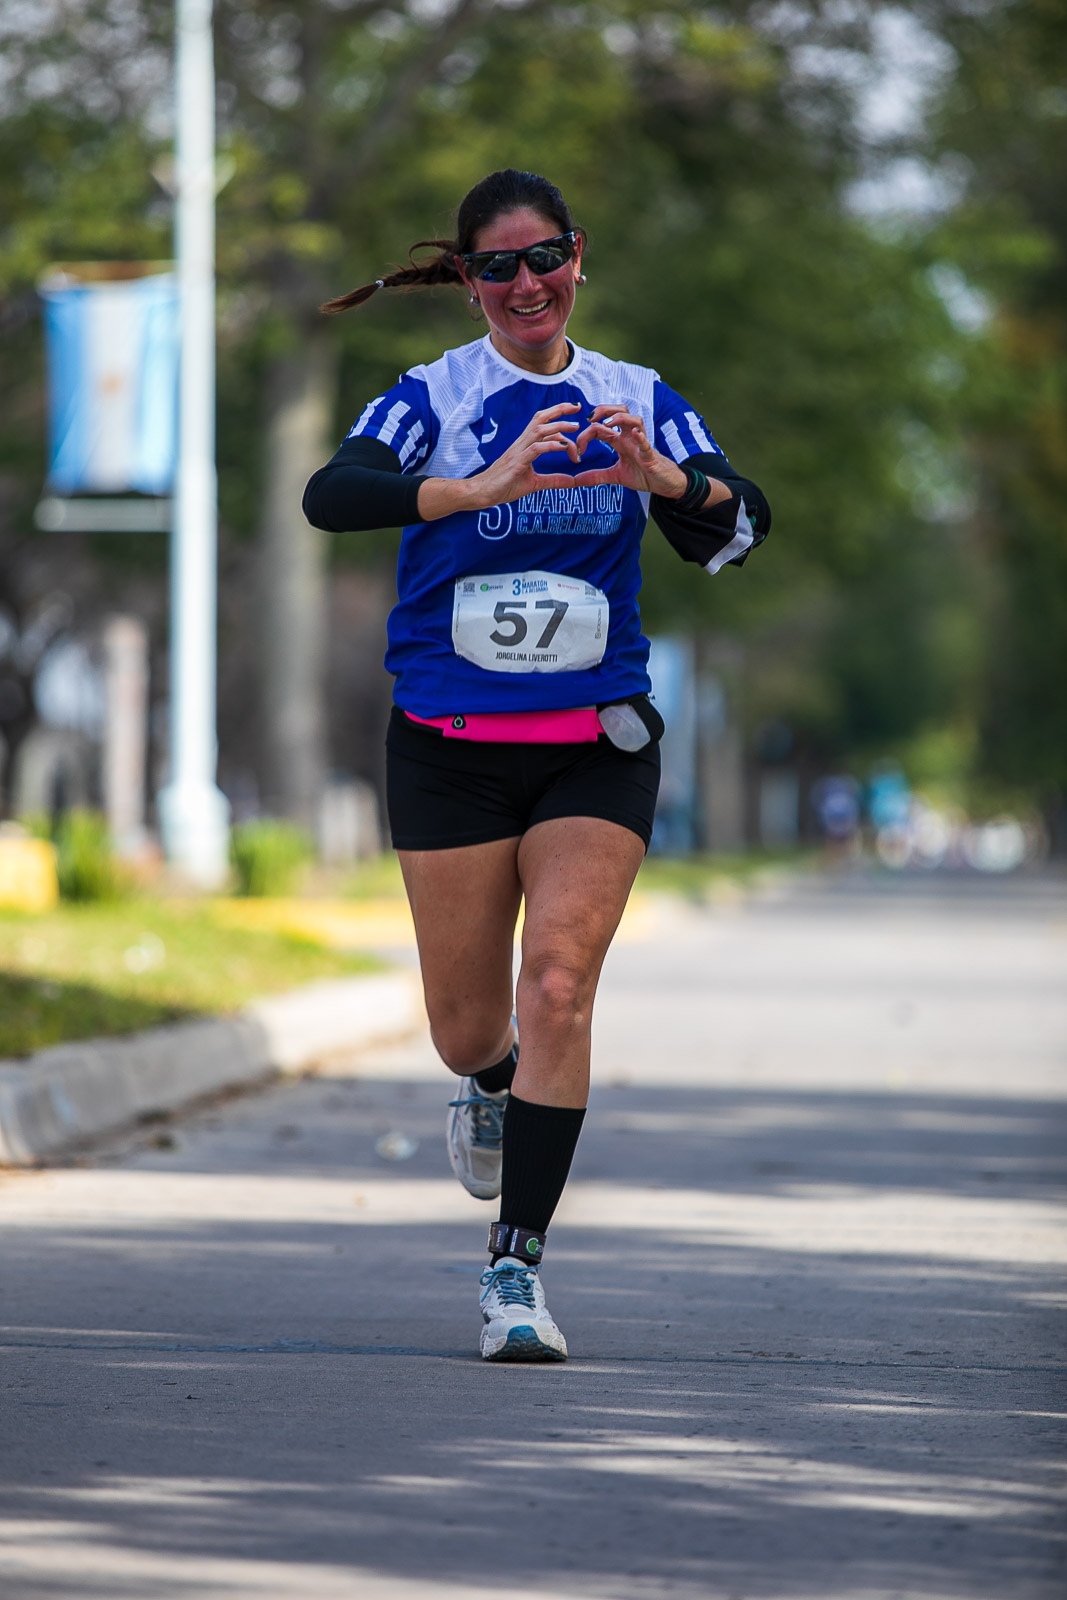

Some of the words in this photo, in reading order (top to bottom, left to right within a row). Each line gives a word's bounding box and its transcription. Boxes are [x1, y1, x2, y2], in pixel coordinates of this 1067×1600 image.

[489, 599, 569, 648] 57
[496, 652, 527, 661] JORGELINA
[528, 653, 558, 663] LIVEROTTI
